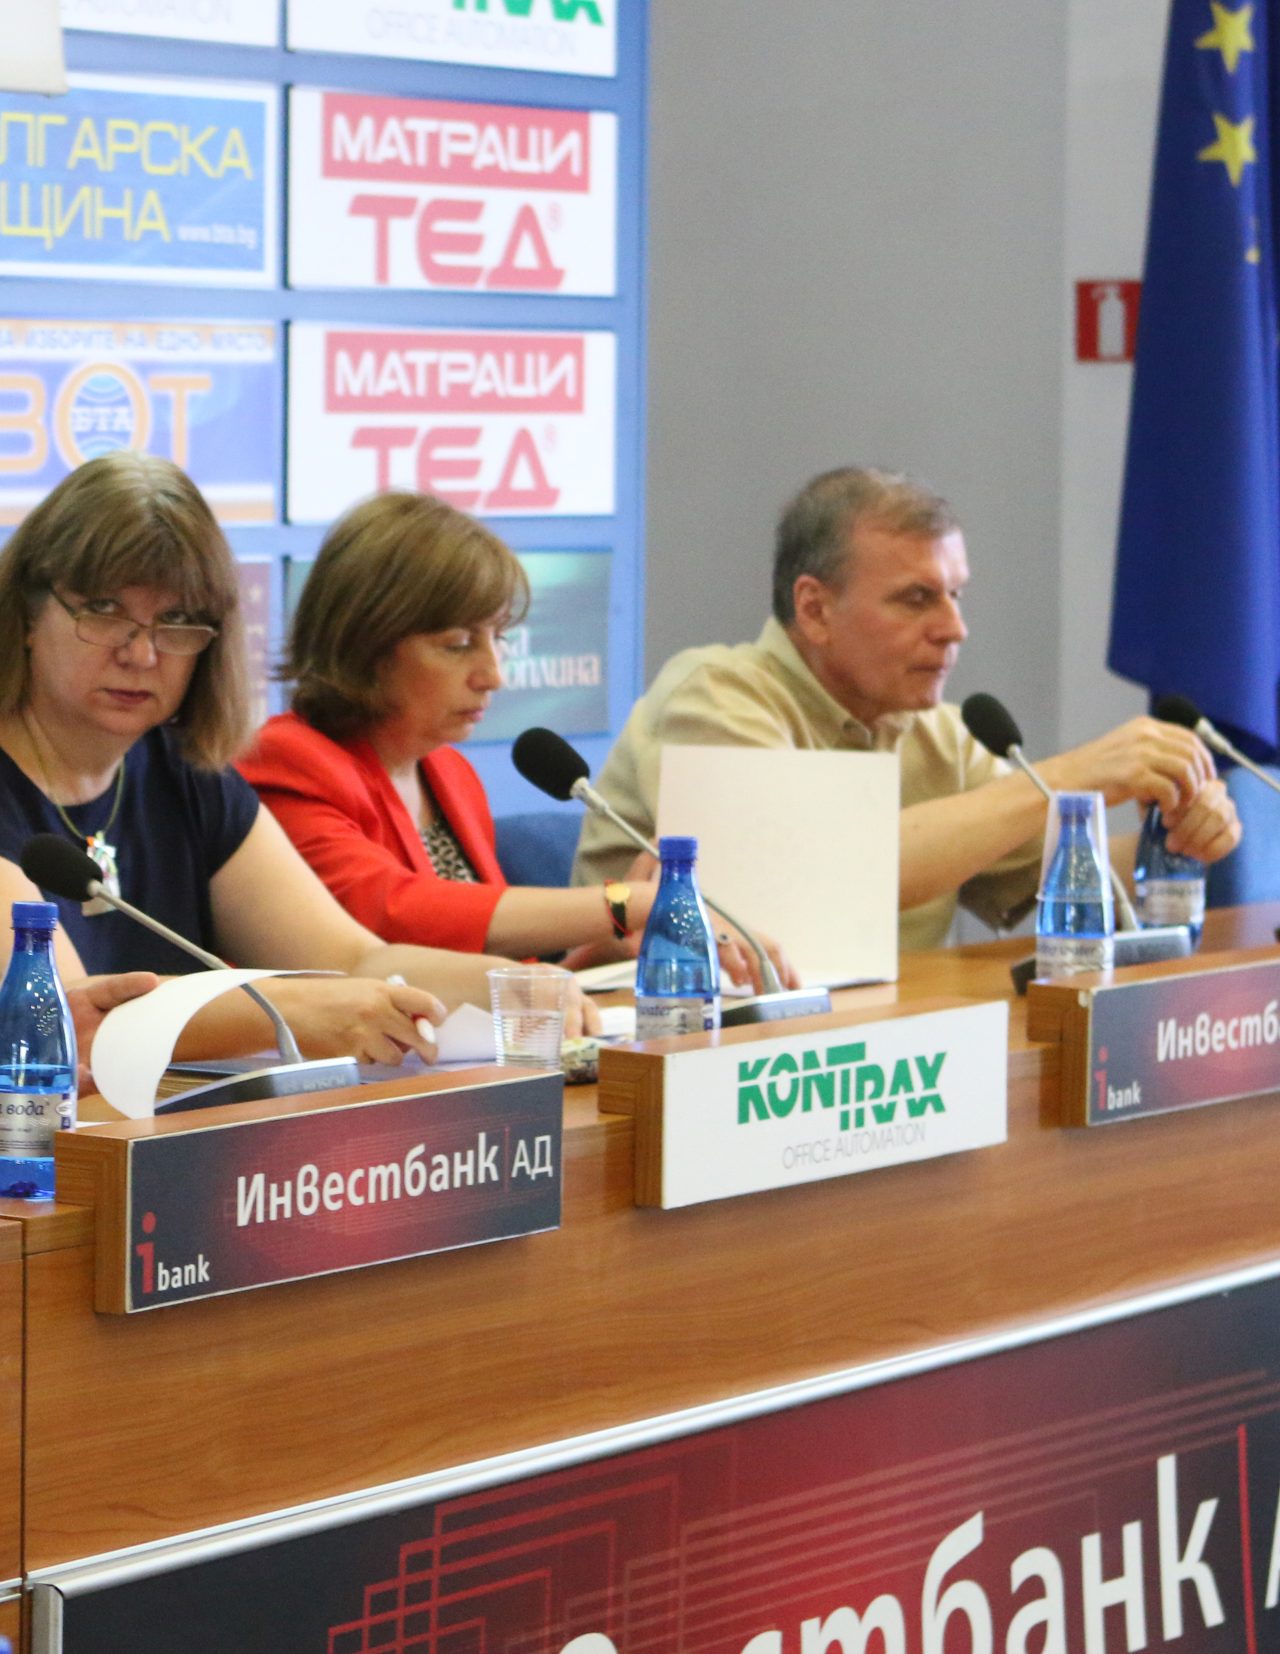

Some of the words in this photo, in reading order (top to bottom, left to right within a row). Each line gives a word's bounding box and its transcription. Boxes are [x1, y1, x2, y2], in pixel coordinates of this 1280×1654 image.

[332, 113, 583, 177] МАТРАЦИ
[334, 351, 577, 400] МАТРАЦИ
[1157, 999, 1280, 1063] Инвестб
[738, 1041, 947, 1131] KONTRAX
[783, 1138, 831, 1170] OFFICE
[835, 1122, 926, 1160] AUTOMATION
[236, 1132, 499, 1227] Инвестбанк
[511, 1135, 554, 1181] АД
